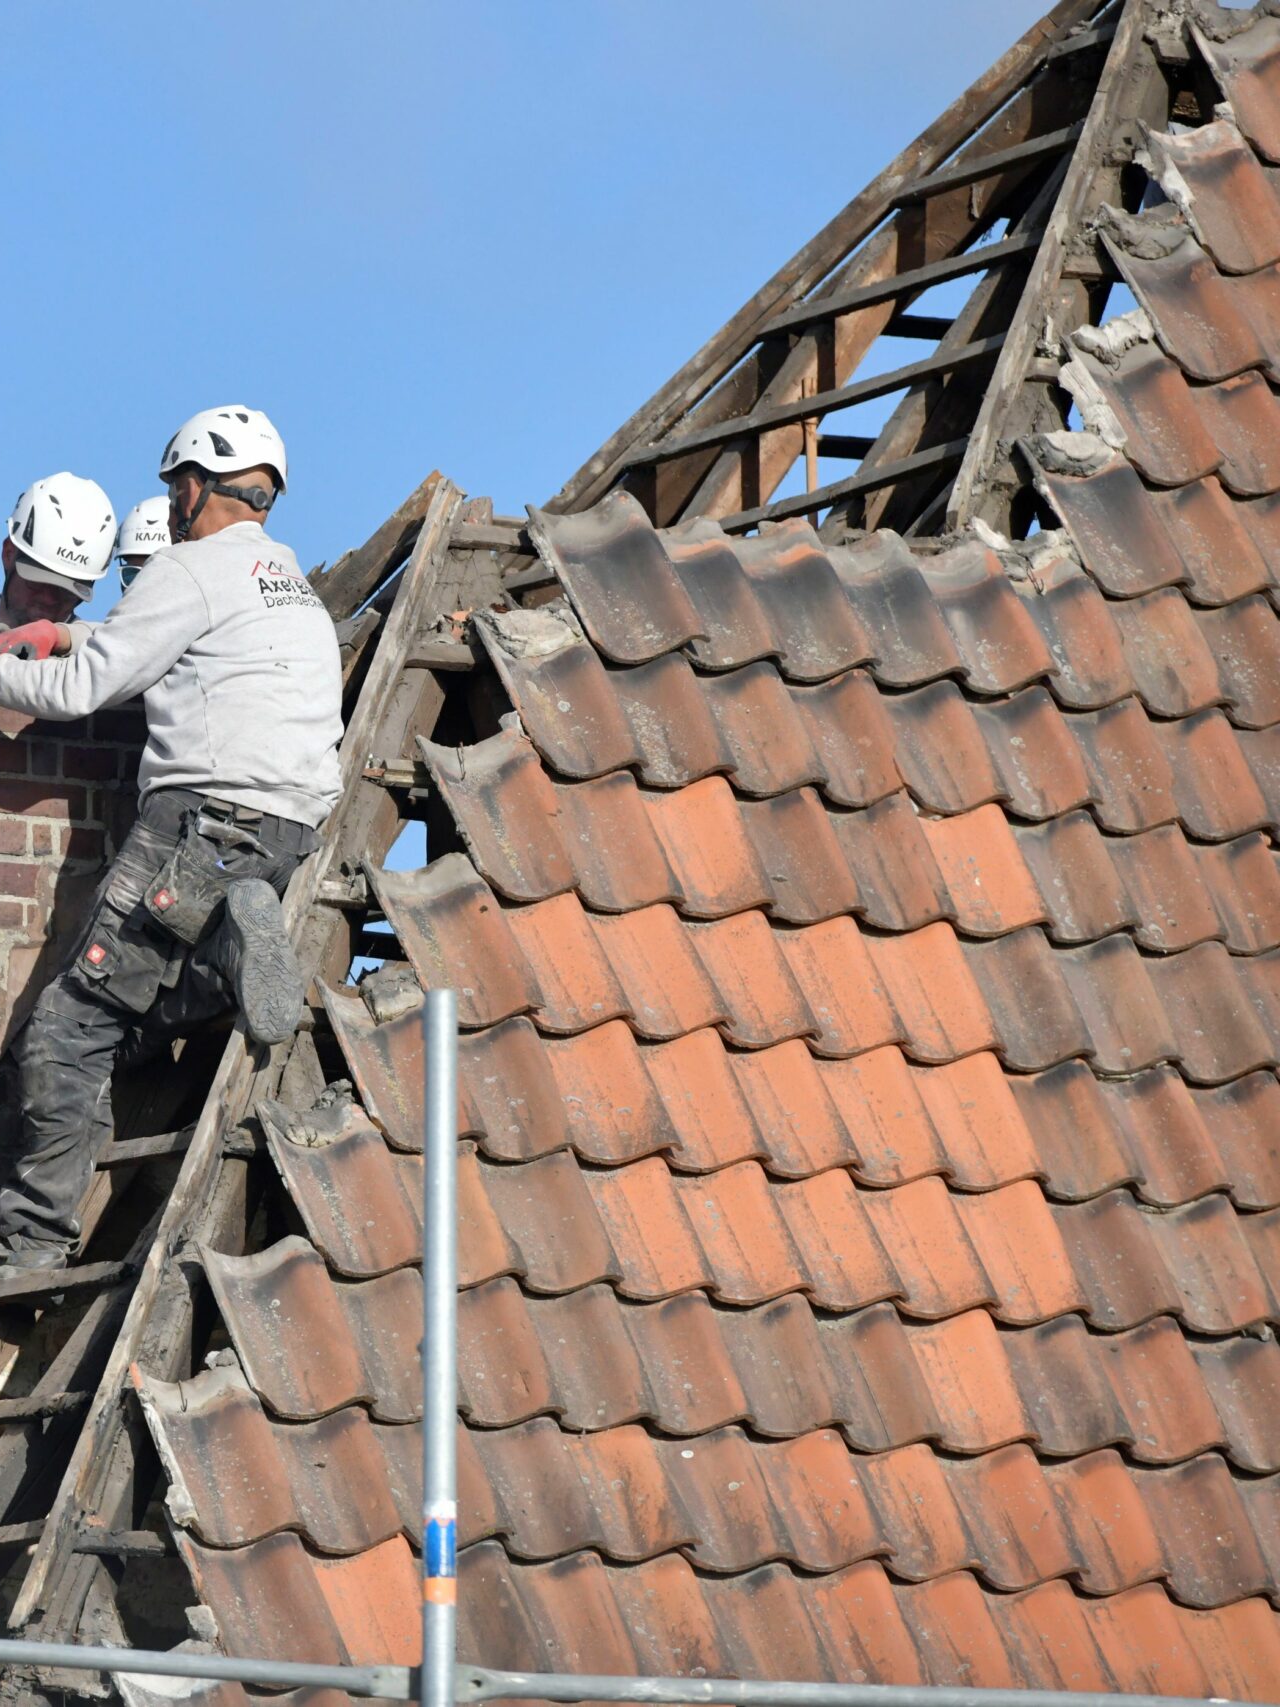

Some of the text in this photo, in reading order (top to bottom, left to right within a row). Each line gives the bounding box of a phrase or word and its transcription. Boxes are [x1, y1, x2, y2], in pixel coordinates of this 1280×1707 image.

[135, 532, 166, 542] KASK
[56, 546, 89, 565] KASK
[258, 577, 297, 594] Axel
